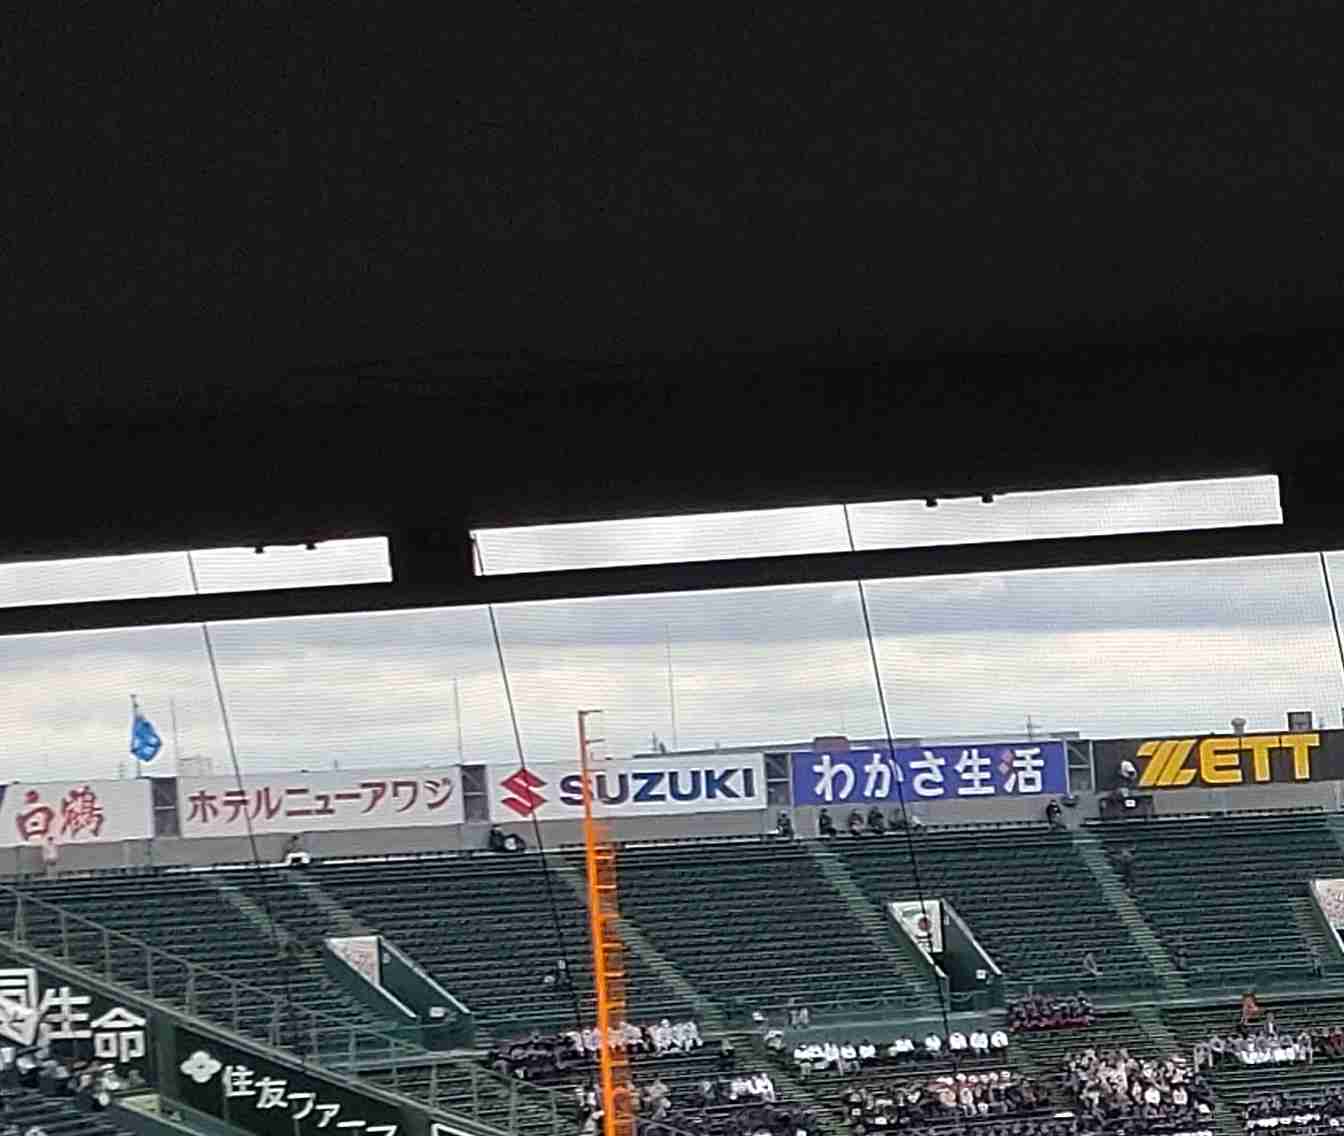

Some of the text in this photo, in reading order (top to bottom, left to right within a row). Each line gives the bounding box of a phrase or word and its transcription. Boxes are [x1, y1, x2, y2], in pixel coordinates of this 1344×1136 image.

[559, 767, 757, 806] SUZUKI
[812, 747, 1045, 803] わかさ生活
[1136, 733, 1321, 788] ZETT
[14, 785, 105, 841] 白鶴
[187, 777, 455, 824] ホテルニューアワジ
